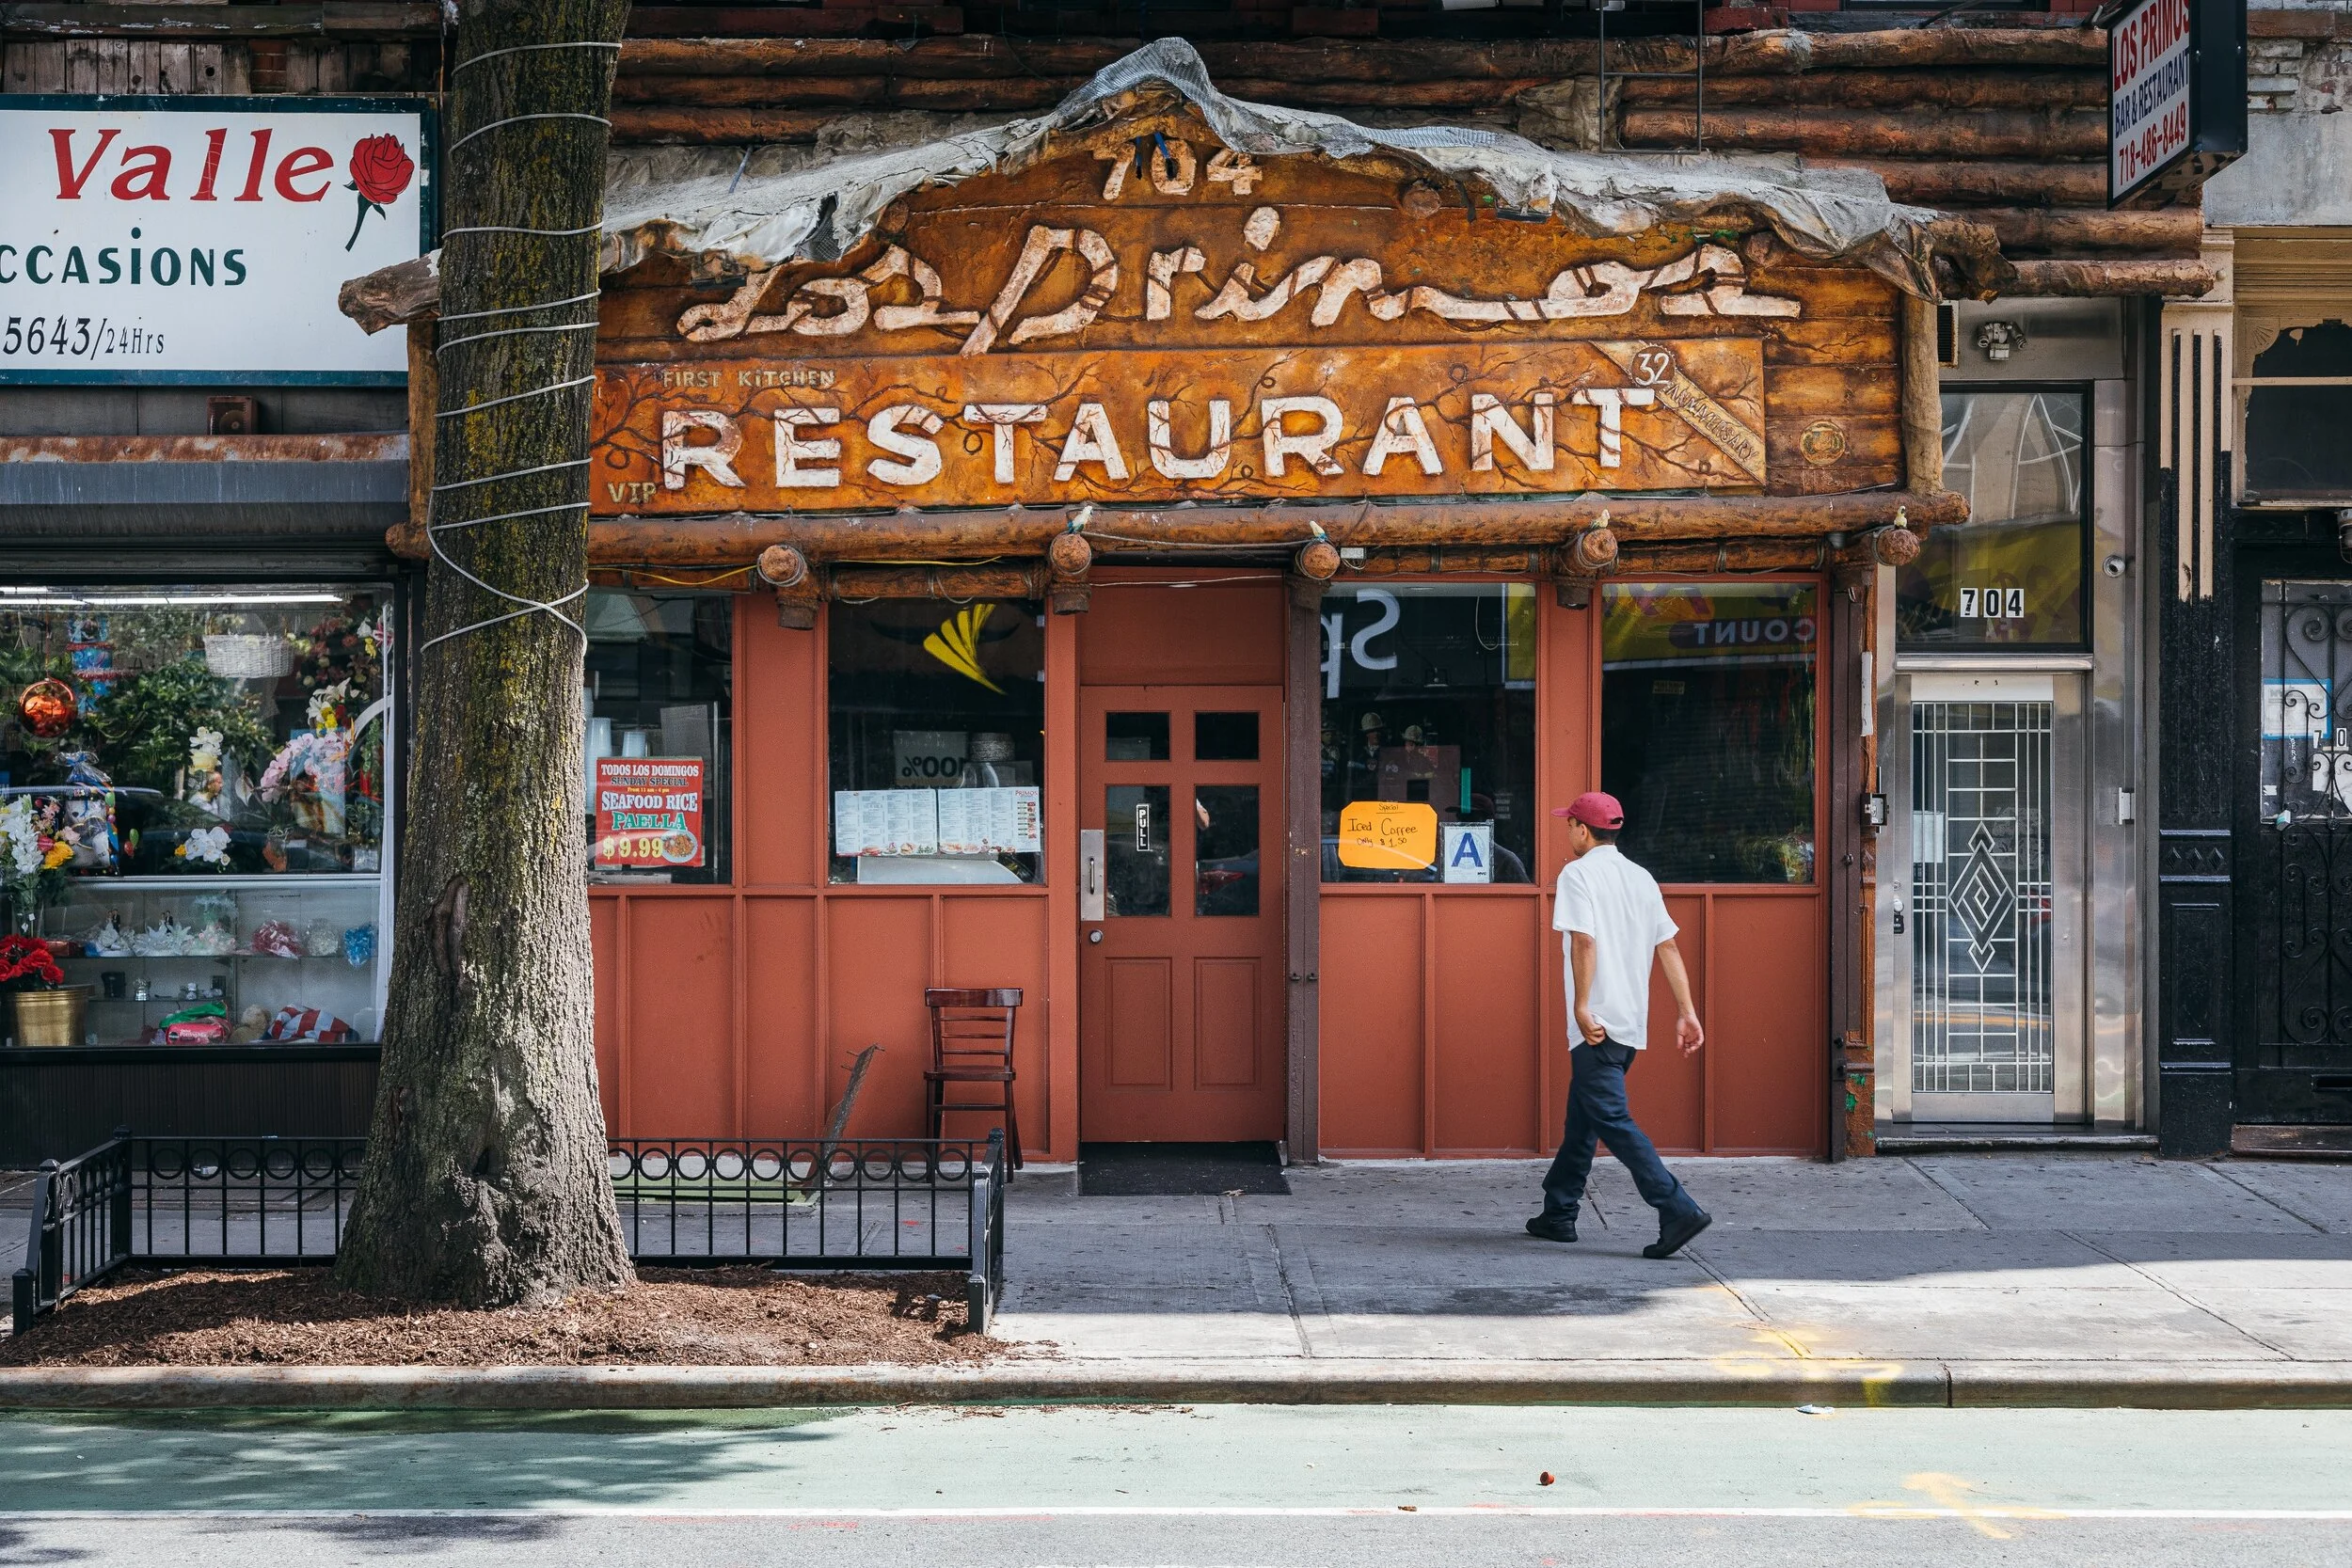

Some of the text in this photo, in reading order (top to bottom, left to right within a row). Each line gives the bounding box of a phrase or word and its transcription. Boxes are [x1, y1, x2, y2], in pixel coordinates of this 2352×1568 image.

[2113, 19, 2137, 92] LOS
[2115, 49, 2190, 139] BAR & RESTAURANT
[2119, 101, 2186, 185] 718-486-8449
[48, 128, 335, 202] Valle
[1091, 134, 1263, 200] 704
[663, 371, 723, 388] FIRST
[1634, 352, 1671, 386] 32
[662, 388, 1655, 490] RESTAURANT
[607, 482, 657, 504] VIP
[1961, 589, 2023, 617] 704
[601, 764, 699, 777] TODOS LOS DOMINGOS
[611, 777, 689, 786] SUNDAY SPECIAL
[602, 790, 698, 813] SEAFOOD RICE
[612, 810, 688, 832] PAELLA
[1138, 809, 1147, 847] PULL
[1347, 818, 1373, 832] Iced
[1451, 832, 1484, 867] A
